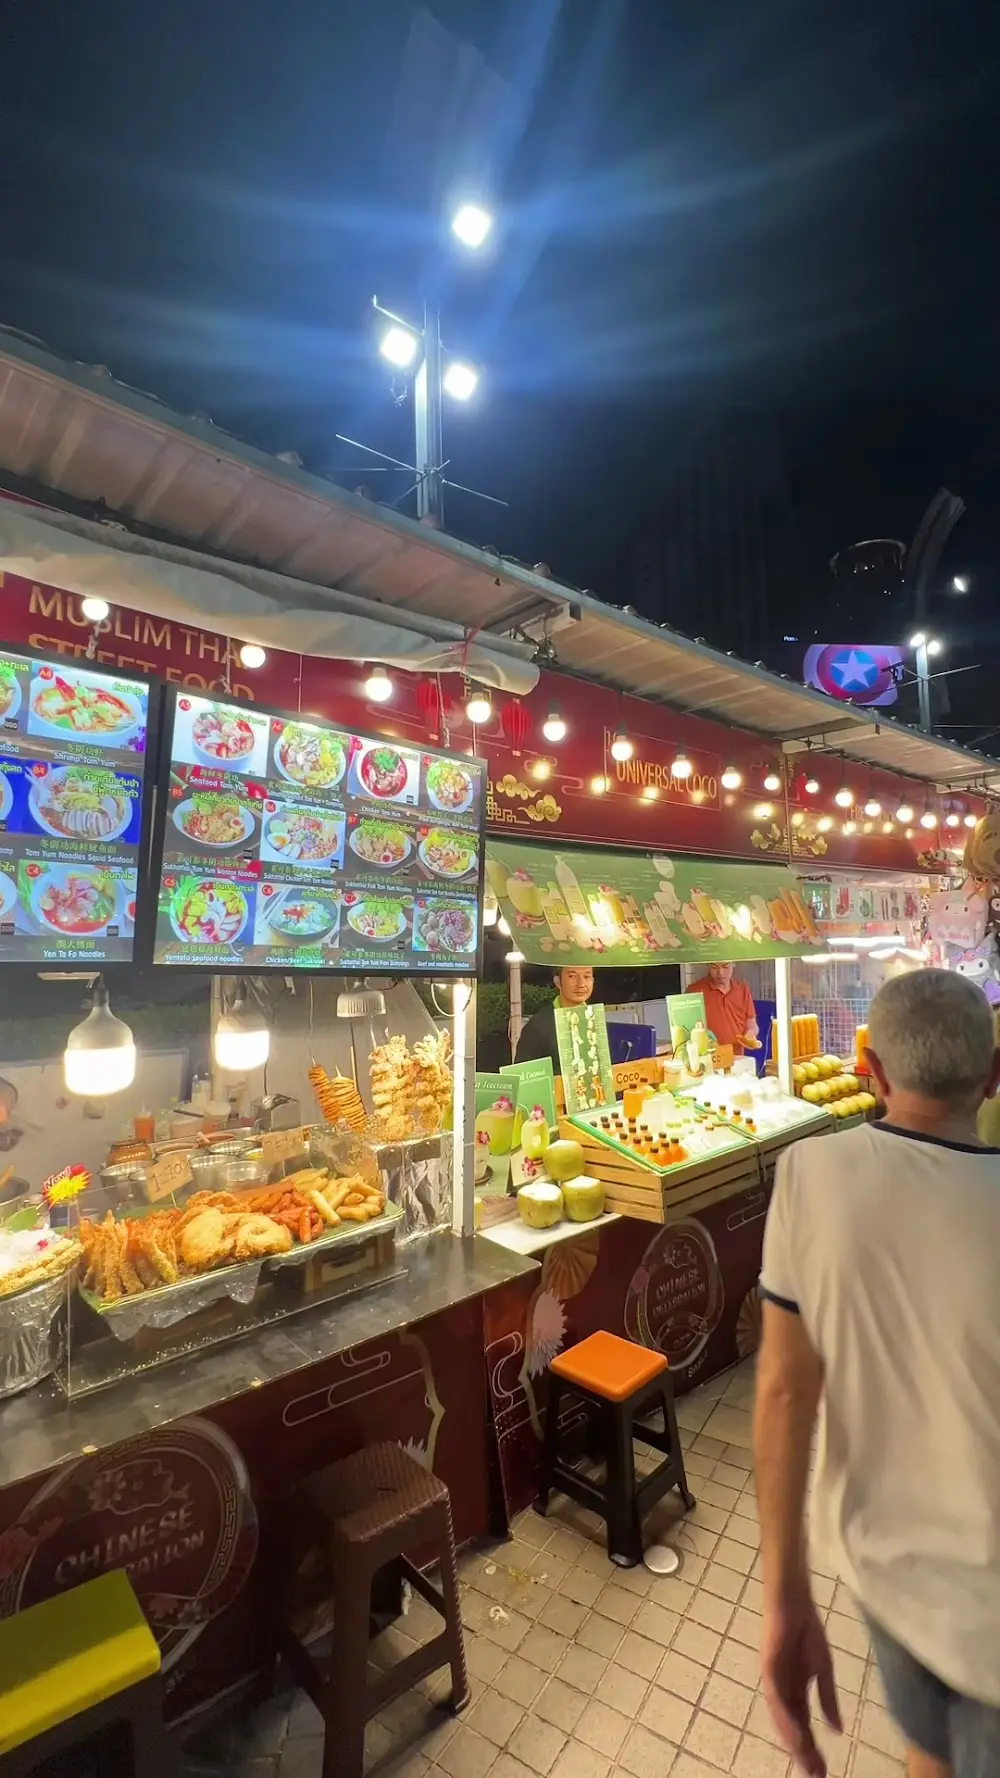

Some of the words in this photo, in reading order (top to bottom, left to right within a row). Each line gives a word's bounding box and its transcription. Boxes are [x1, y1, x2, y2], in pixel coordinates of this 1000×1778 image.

[53, 751, 80, 763] Shrimp
[83, 755, 98, 765] Tom
[100, 758, 115, 767] Yum
[189, 775, 218, 787] Seafood
[220, 781, 232, 789] Tom
[25, 848, 40, 857] Tom
[42, 849, 57, 858] Yum
[58, 851, 86, 860] Noodles
[88, 853, 106, 863] Squid
[108, 855, 134, 864] Seafood
[44, 950, 56, 958] Yen
[79, 951, 106, 959] Noodles
[165, 953, 191, 961] Yentafo
[220, 955, 243, 963] noodles
[54, 1502, 196, 1584] CHINESE
